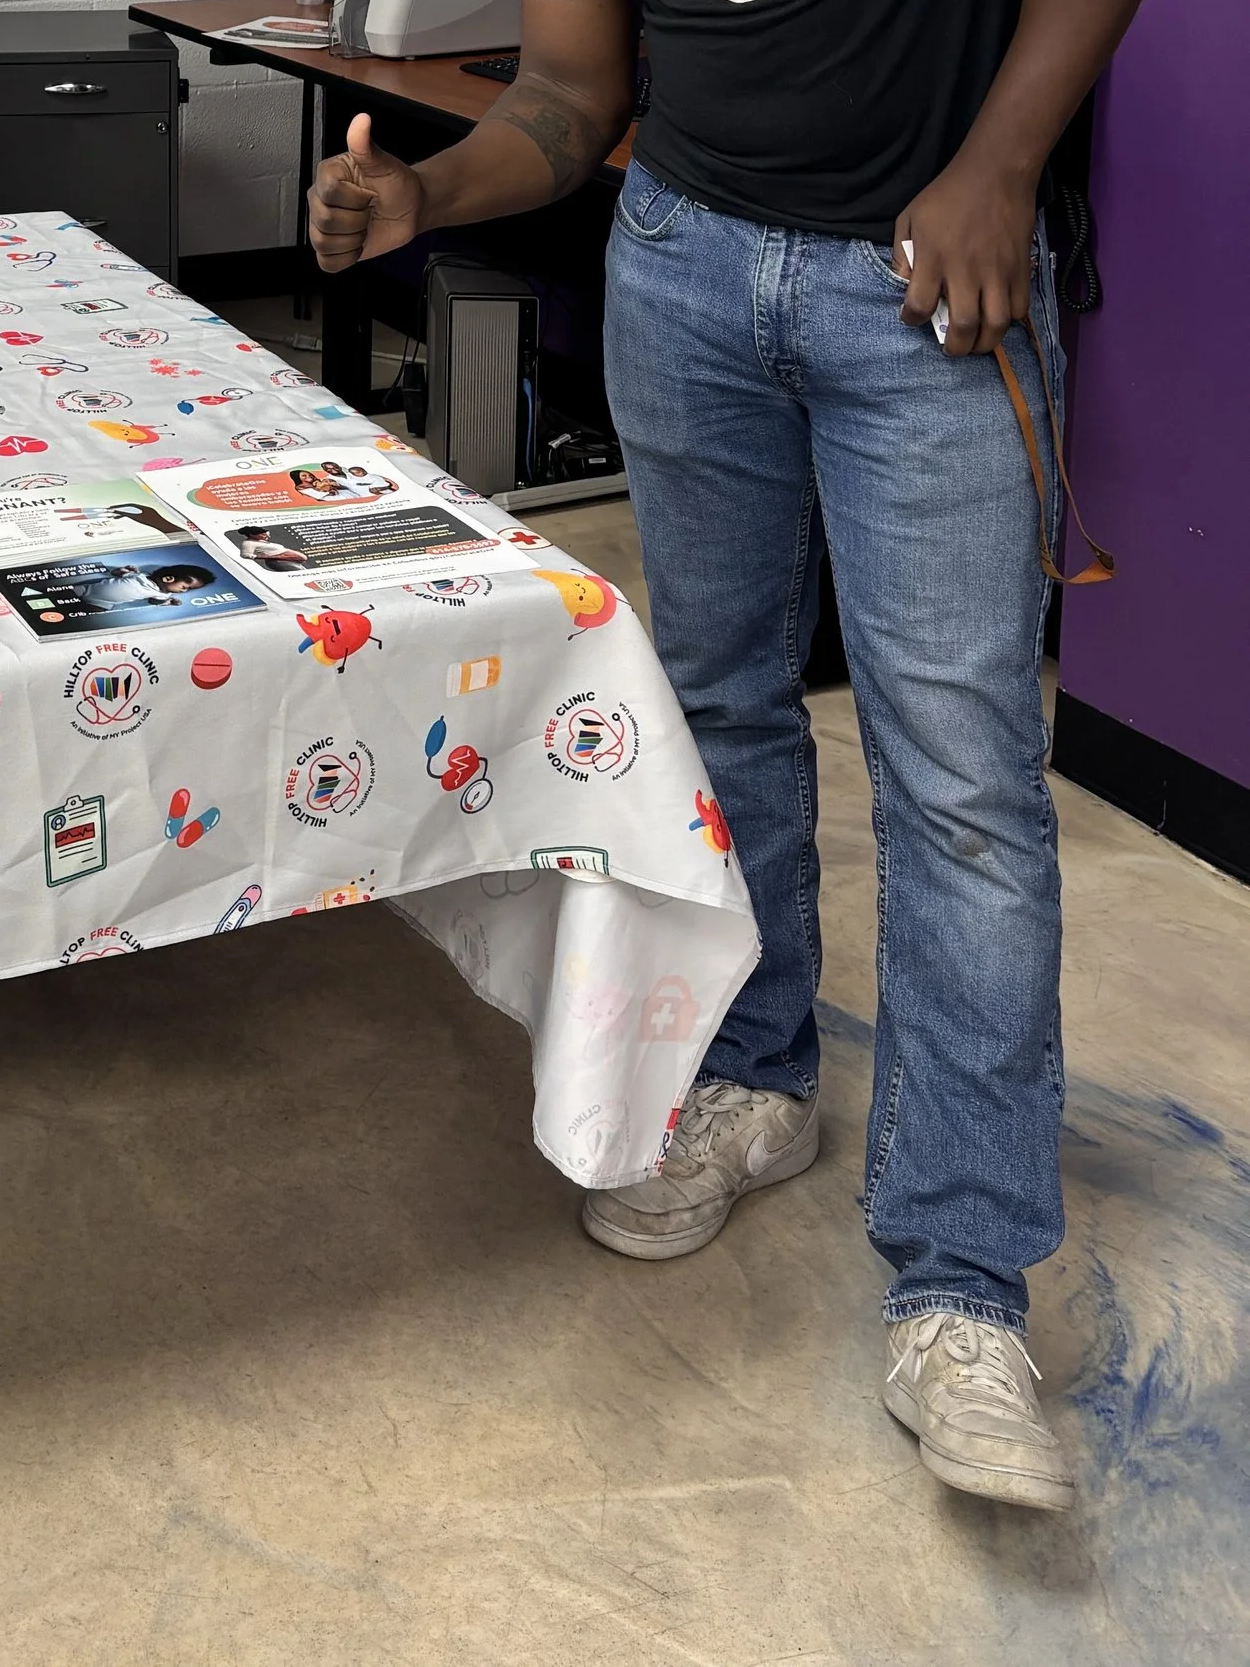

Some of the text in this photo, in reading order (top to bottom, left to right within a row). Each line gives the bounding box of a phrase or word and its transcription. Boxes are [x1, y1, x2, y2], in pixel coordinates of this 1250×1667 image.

[6, 571, 42, 580] Always
[43, 566, 77, 577] Follow
[53, 570, 77, 578] Safe
[79, 567, 107, 575] Sleep
[46, 584, 74, 593] Alone
[57, 597, 81, 605] Back
[190, 592, 239, 607] ONE
[64, 643, 159, 698] HILLTOP FREE CLINIC
[545, 692, 595, 782] HILLTOP FREE CLINIC
[286, 736, 334, 827] HILLTOP FREE CLINIC
[90, 927, 118, 941] FREE
